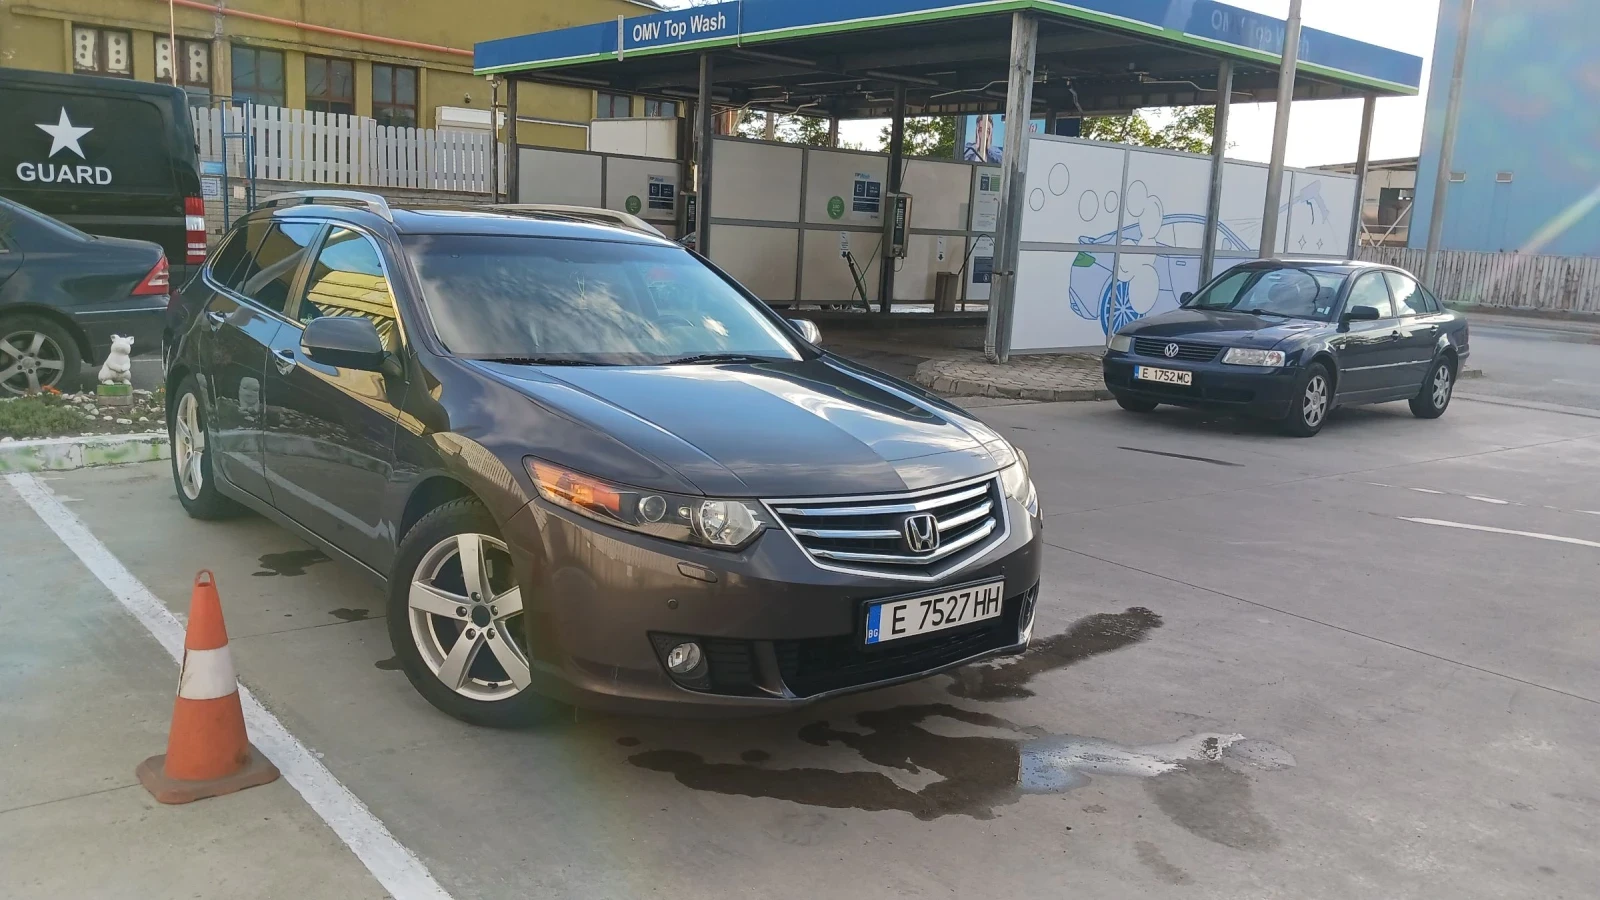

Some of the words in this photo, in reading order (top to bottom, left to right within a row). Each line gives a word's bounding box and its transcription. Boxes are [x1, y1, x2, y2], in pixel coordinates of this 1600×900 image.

[633, 21, 661, 42] OMV
[664, 19, 686, 40] Top
[690, 11, 726, 33] Wash
[16, 162, 112, 185] GUARD
[1142, 367, 1149, 379] E
[1154, 370, 1176, 382] 1752
[1177, 372, 1190, 384] MC
[892, 604, 907, 635] E
[919, 592, 971, 630] 7527
[973, 586, 1001, 618] HH
[868, 629, 879, 639] BG
